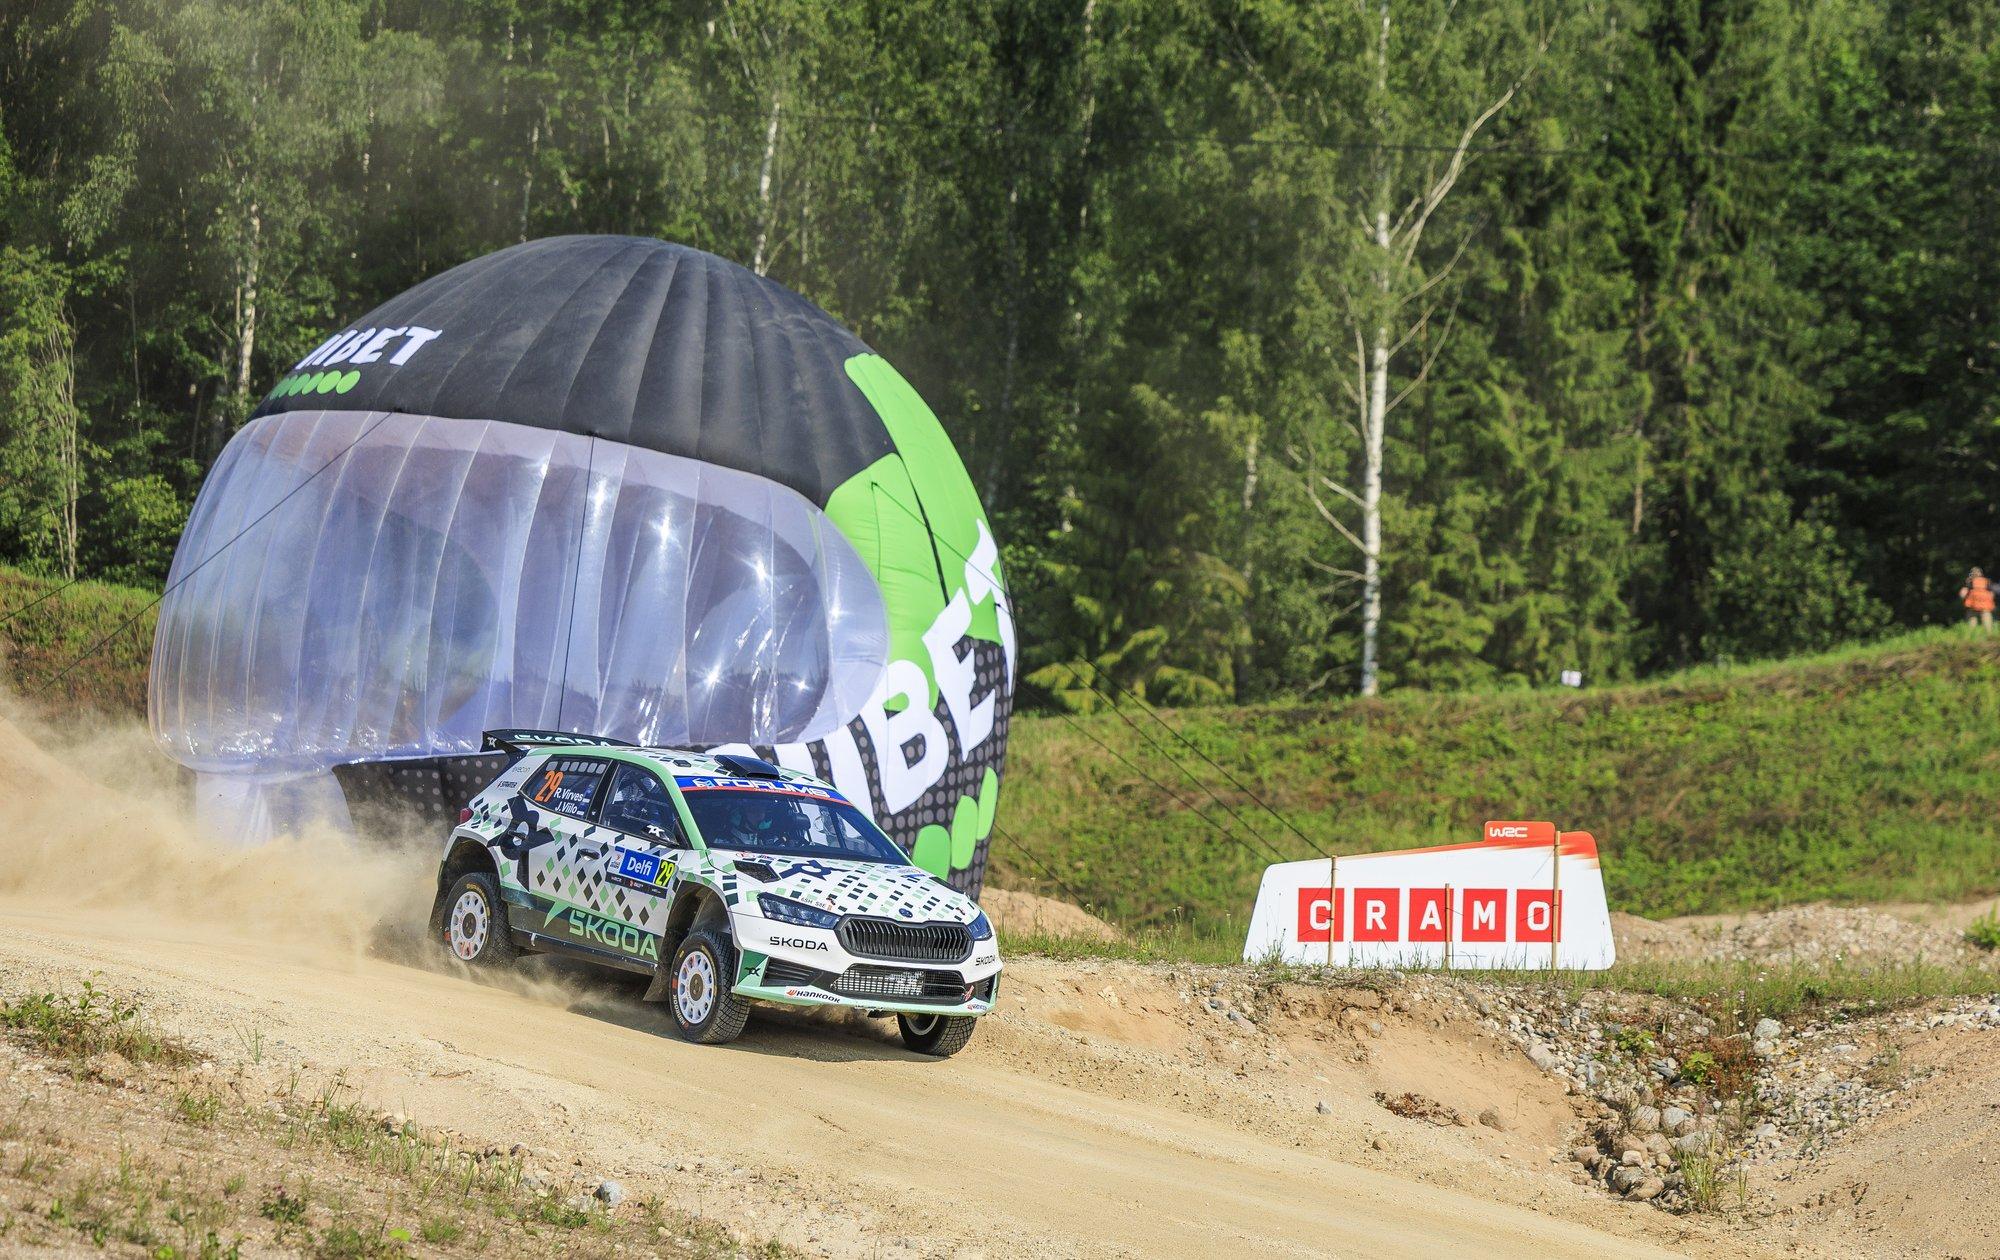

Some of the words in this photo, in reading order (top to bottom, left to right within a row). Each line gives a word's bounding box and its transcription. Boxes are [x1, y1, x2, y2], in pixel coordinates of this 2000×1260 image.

[534, 770, 564, 803] 29
[1489, 826, 1528, 838] WRC
[626, 856, 653, 876] Delfi
[655, 861, 676, 887] 29
[1309, 899, 1551, 931] CRAMO
